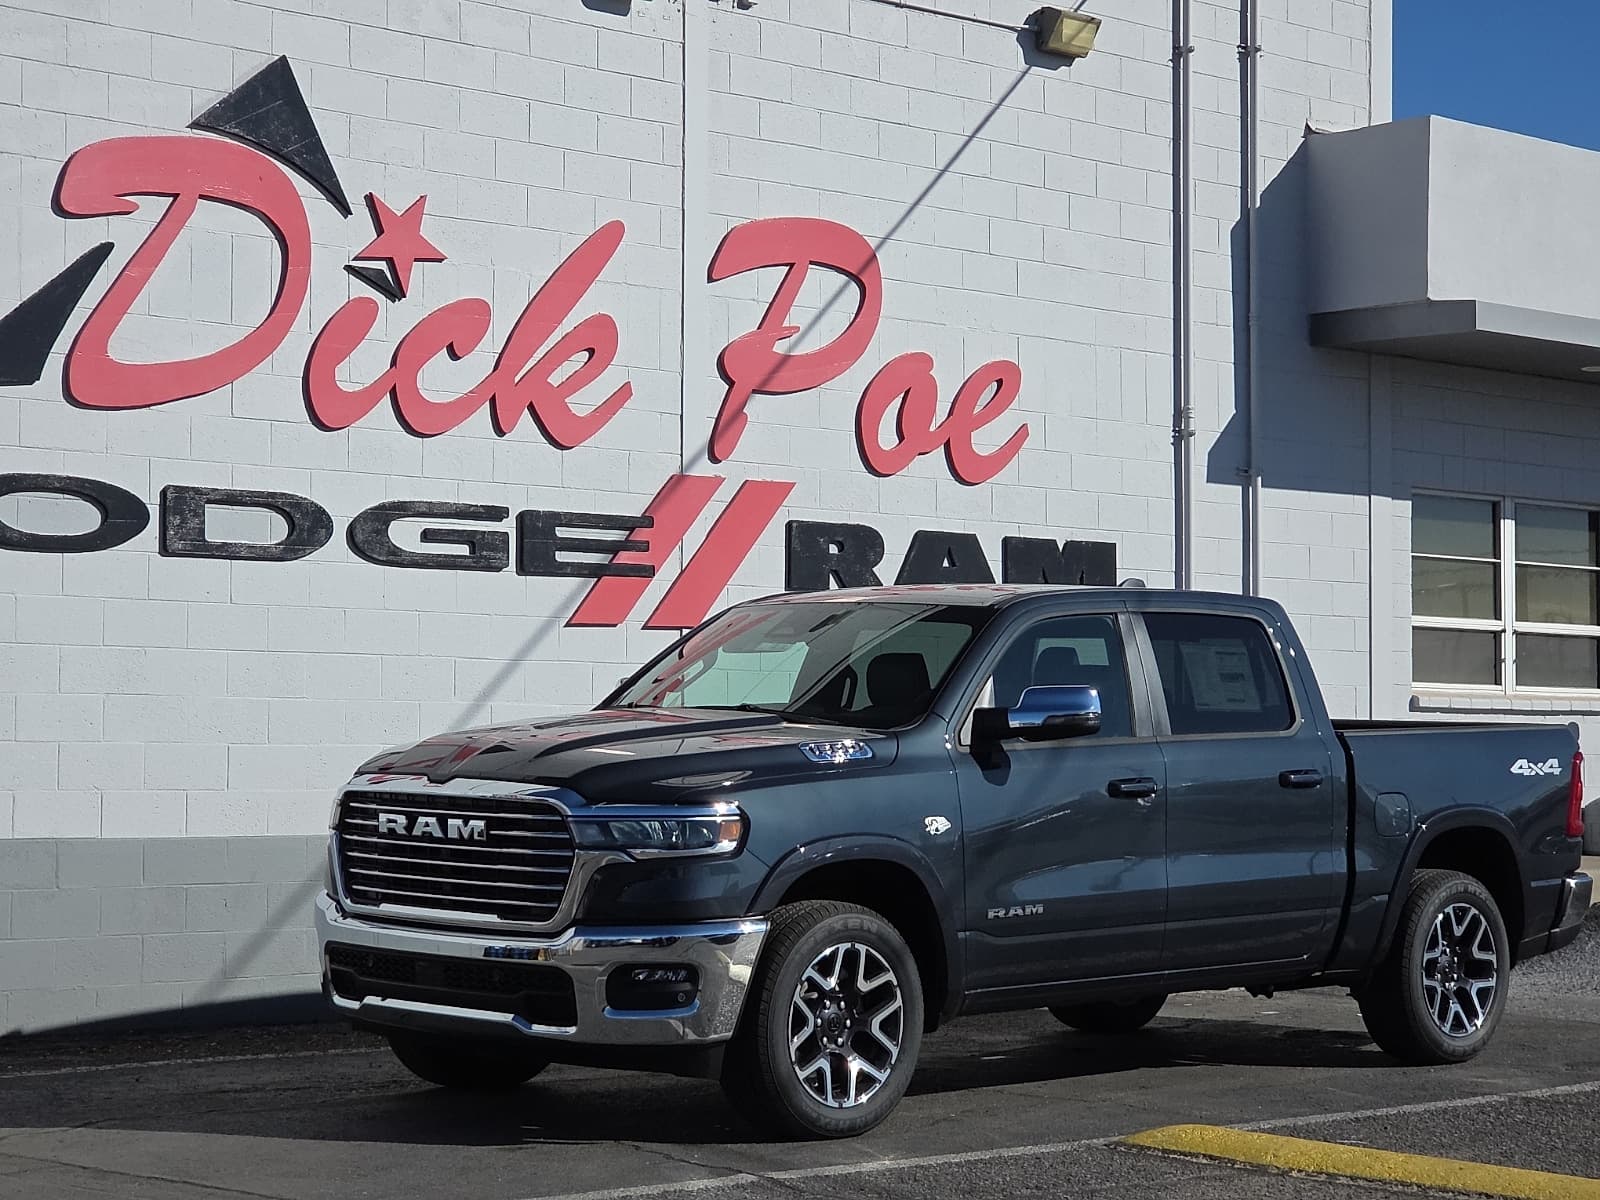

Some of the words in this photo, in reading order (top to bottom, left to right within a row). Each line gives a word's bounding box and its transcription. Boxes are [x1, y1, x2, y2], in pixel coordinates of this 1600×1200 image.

[52, 136, 633, 450] Dick
[707, 216, 1030, 486] Poe
[785, 519, 1117, 592] RAM
[1510, 758, 1562, 776] 4x4
[378, 812, 487, 841] RAM
[987, 903, 1044, 919] RAM
